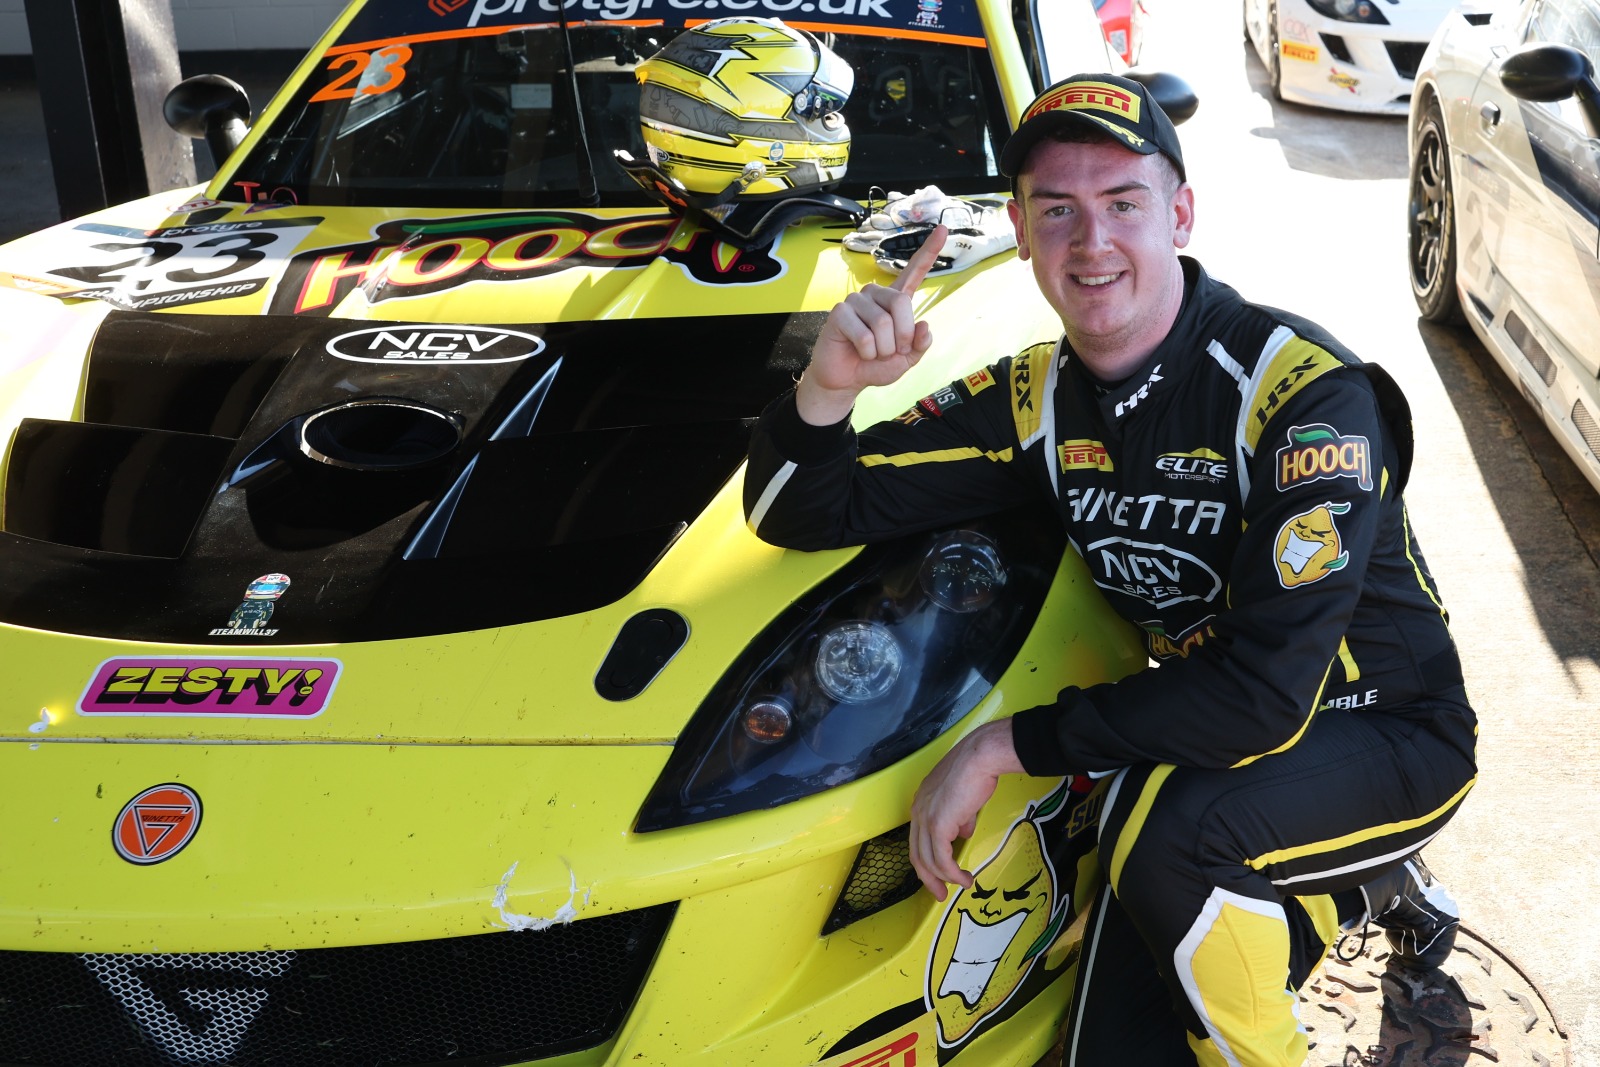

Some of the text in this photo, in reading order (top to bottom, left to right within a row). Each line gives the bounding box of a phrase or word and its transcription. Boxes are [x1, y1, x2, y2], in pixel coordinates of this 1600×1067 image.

[309, 45, 413, 102] 23
[163, 220, 263, 237] protyre
[46, 232, 279, 295] 23
[367, 331, 509, 352] NCV
[383, 351, 471, 361] SALES
[1115, 363, 1164, 417] HRX
[1256, 355, 1319, 426] HRX
[1155, 457, 1229, 479] ELITE
[1282, 443, 1366, 484] HOOCH
[1101, 550, 1181, 583] NCV
[1123, 583, 1182, 599] SAES
[208, 629, 280, 637] #TEAMWILL37
[98, 667, 323, 705] ZESTY!
